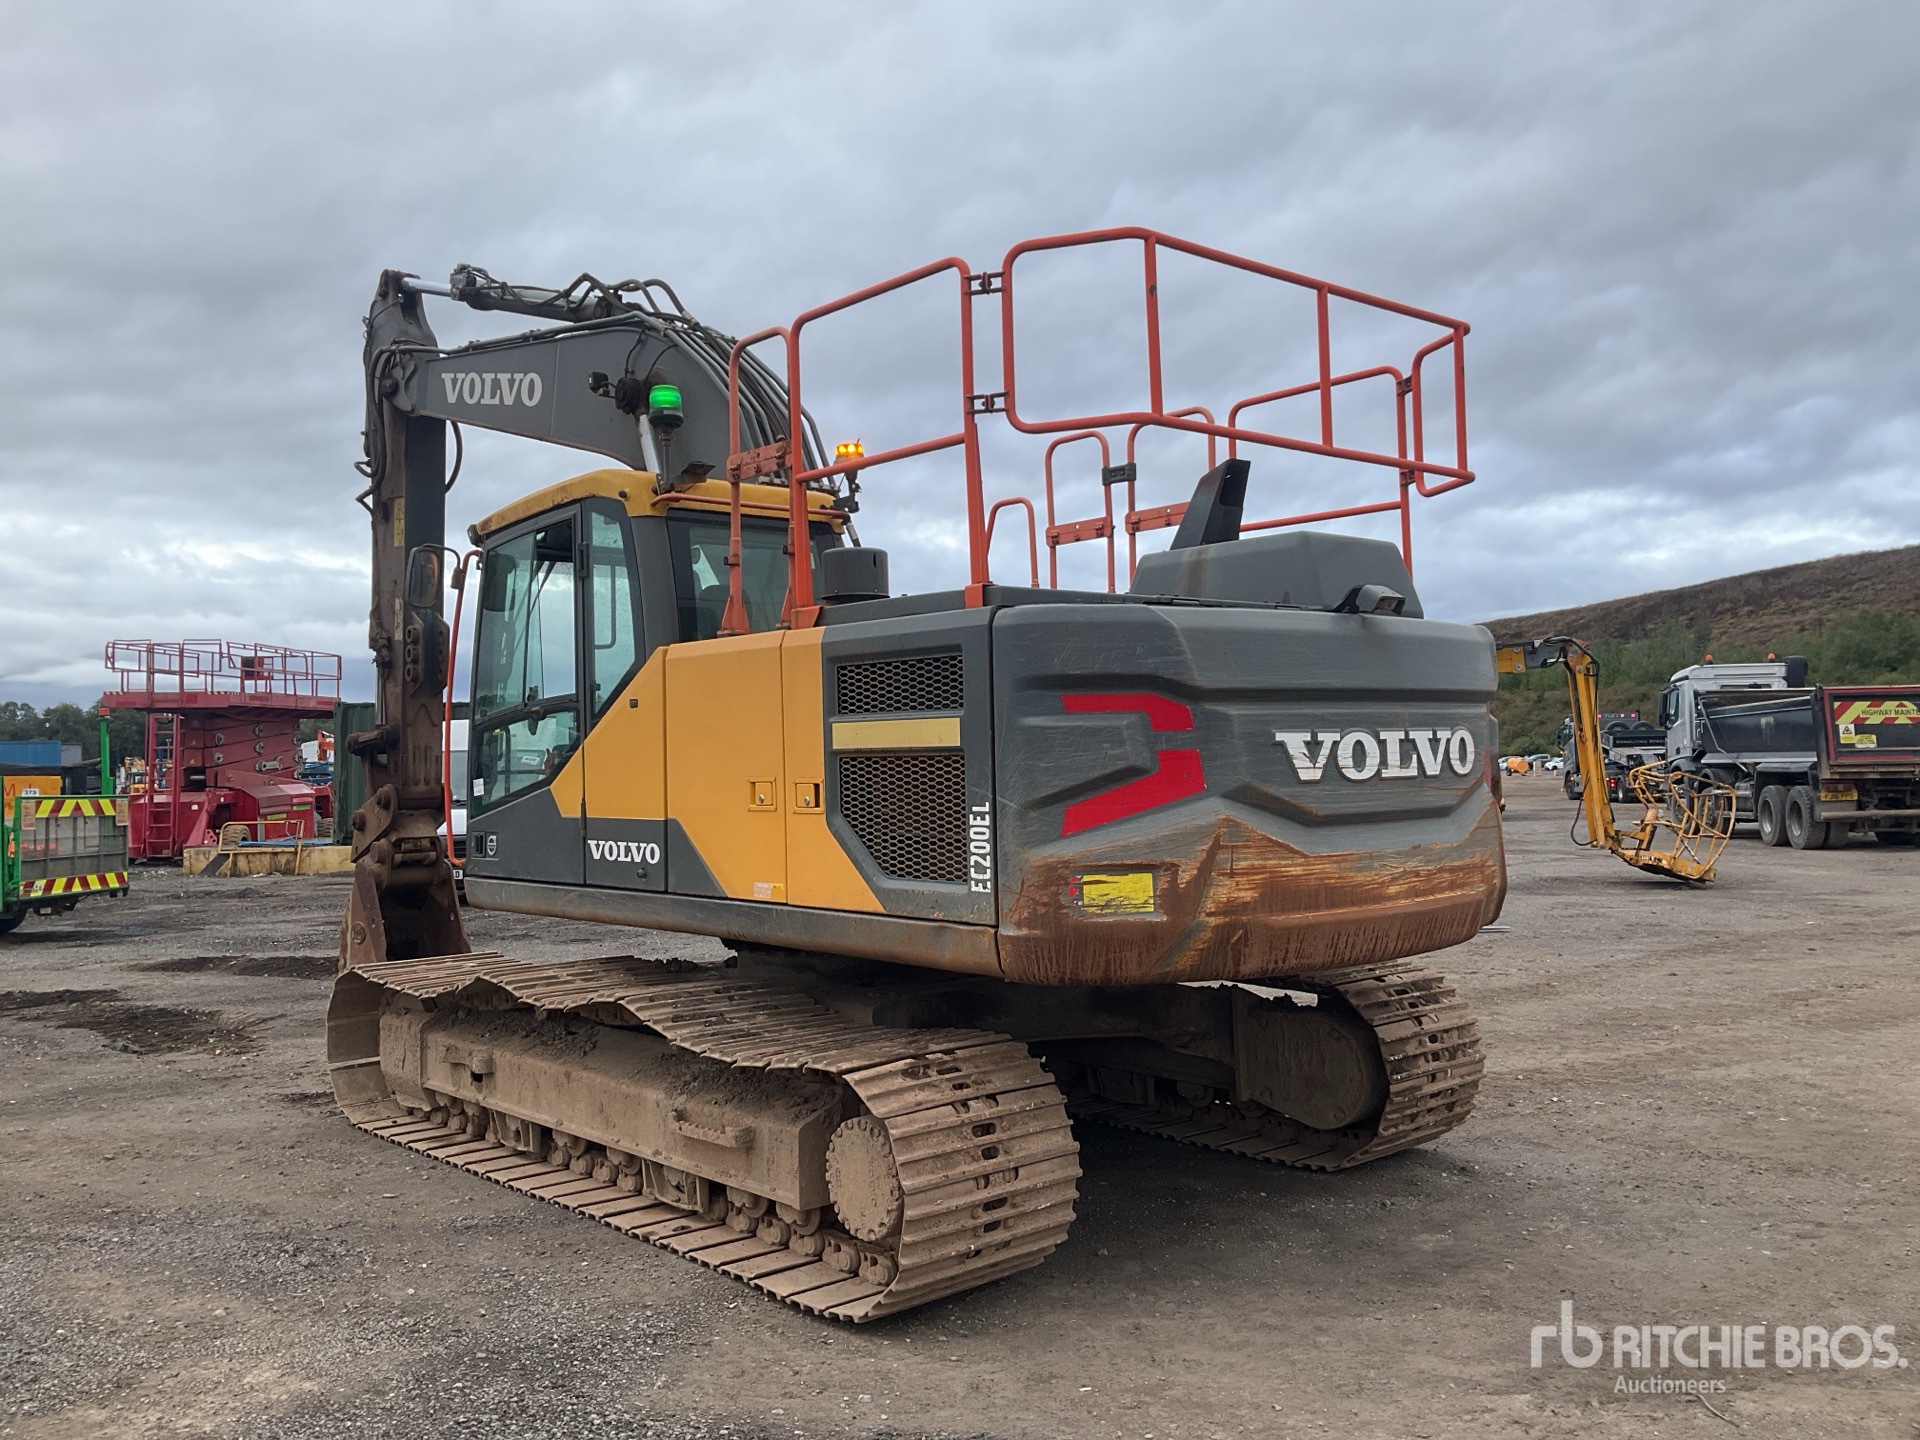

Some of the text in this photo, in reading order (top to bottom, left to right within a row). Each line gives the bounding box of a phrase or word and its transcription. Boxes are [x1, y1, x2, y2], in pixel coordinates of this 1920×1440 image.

[442, 372, 543, 407] VOLVO
[1861, 708, 1893, 716] HIGHWAY
[1274, 728, 1475, 782] VOLVO
[587, 839, 660, 864] VOLVO
[969, 801, 991, 893] EC200EL
